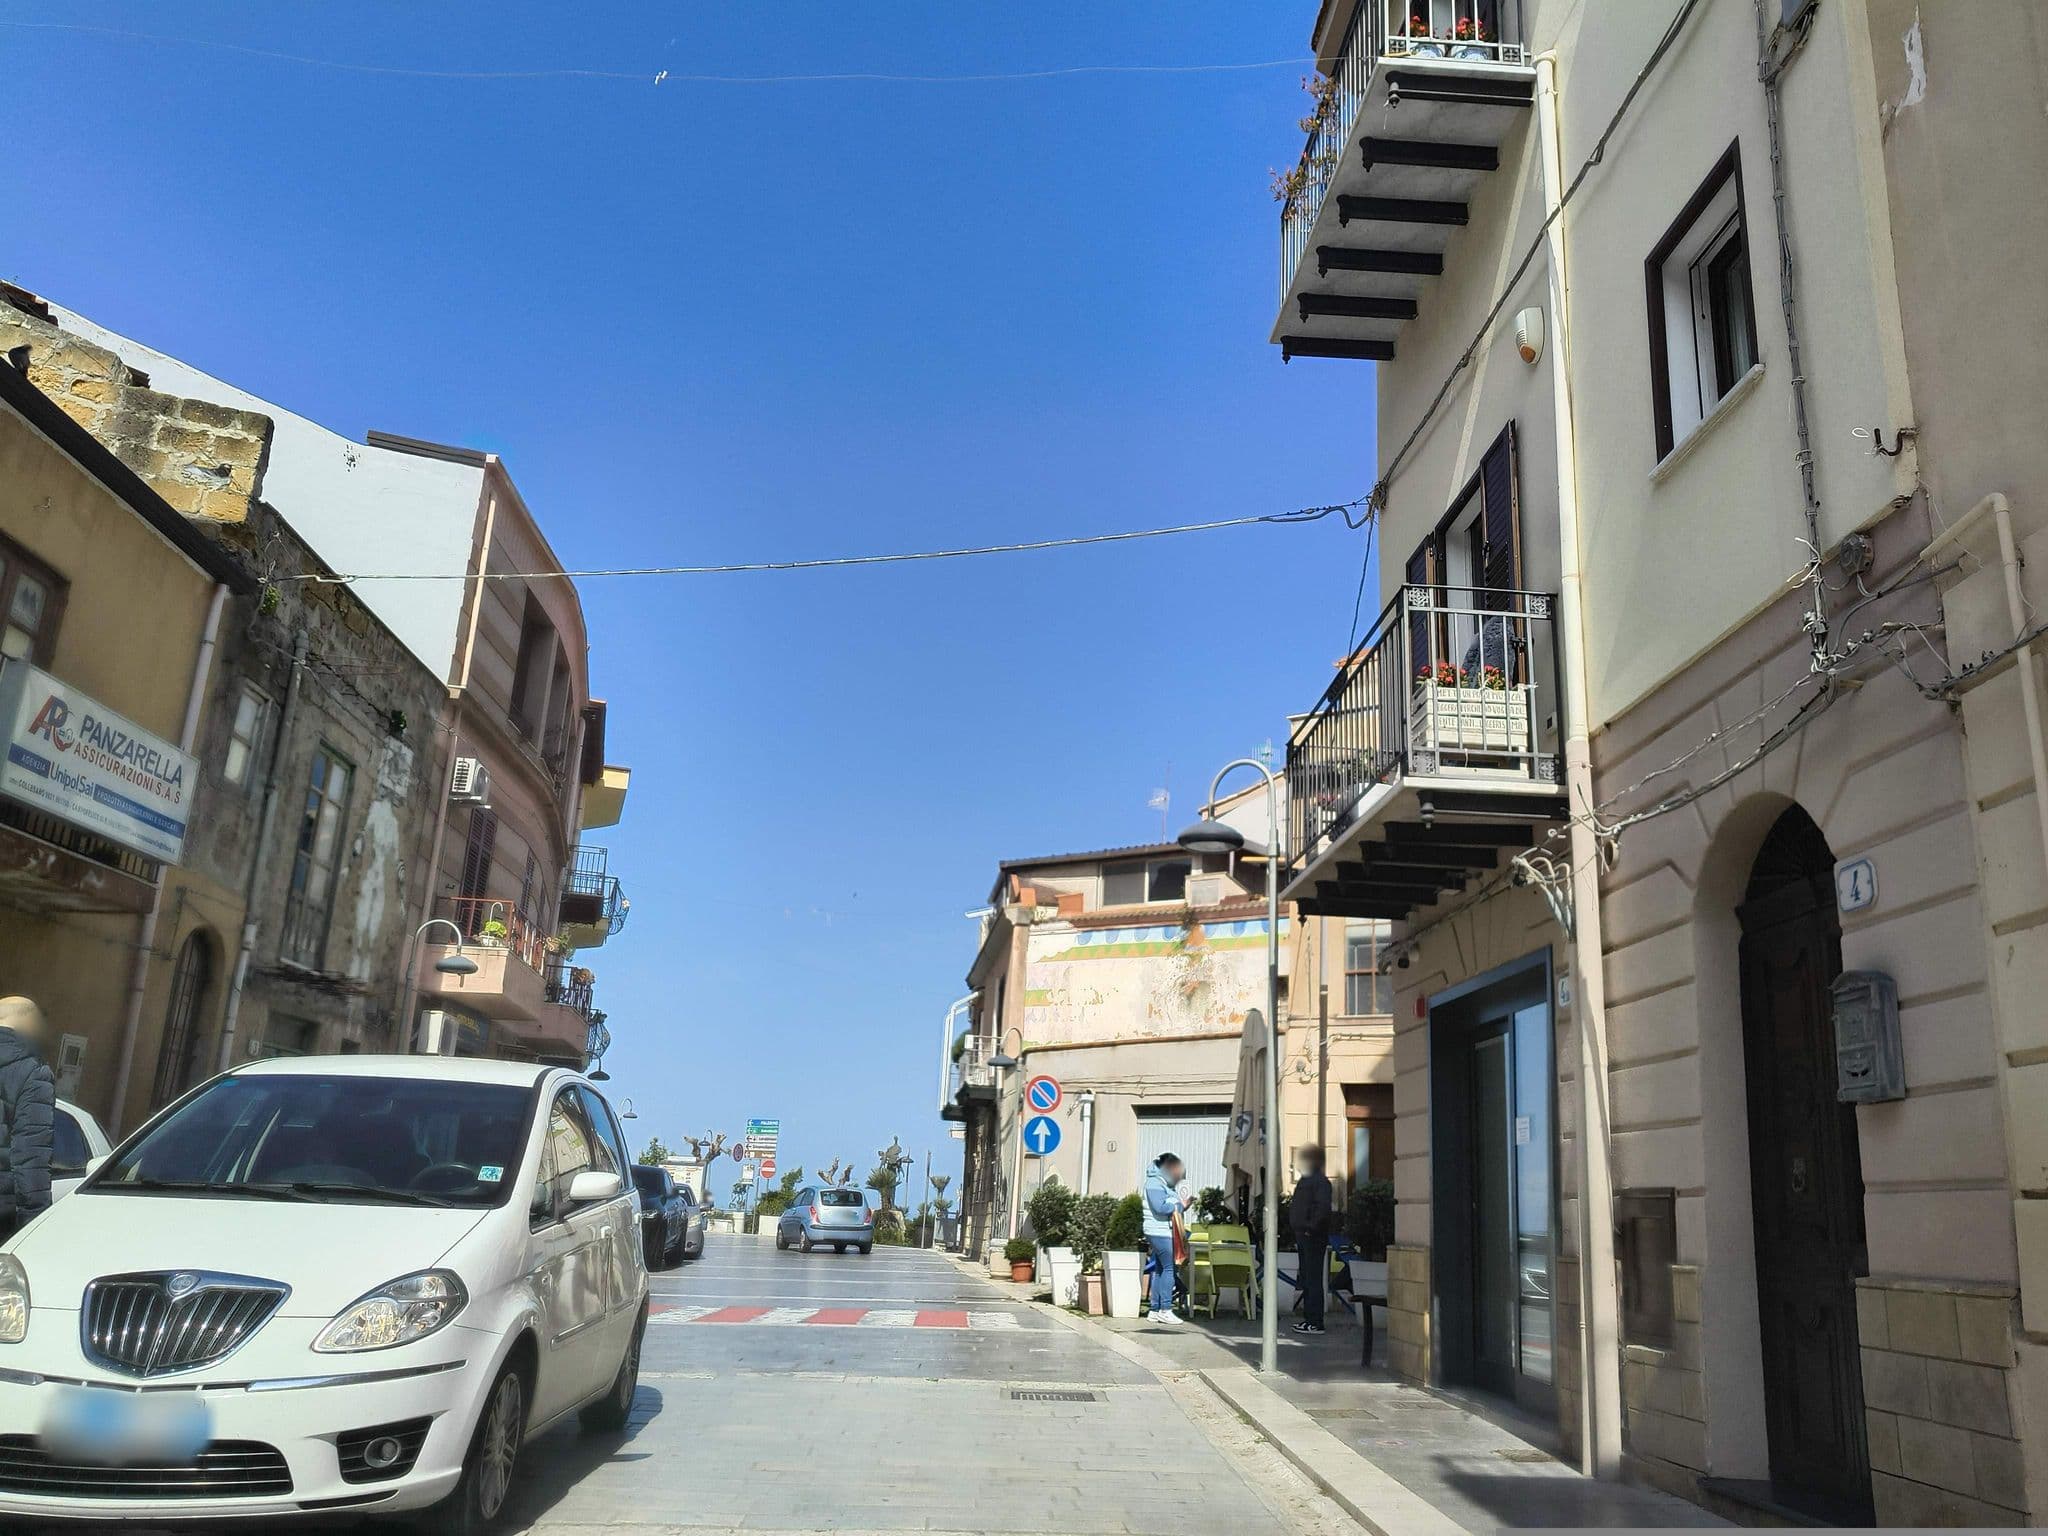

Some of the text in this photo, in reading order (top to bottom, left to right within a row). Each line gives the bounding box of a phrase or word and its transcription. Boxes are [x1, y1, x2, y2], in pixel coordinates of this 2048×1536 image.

[74, 741, 153, 791] ASSICURAZIONI
[79, 714, 183, 788] PANZARELLA
[20, 753, 46, 771] AGENZIA
[49, 761, 94, 798] UnipolSai
[1850, 869, 1861, 901] 4
